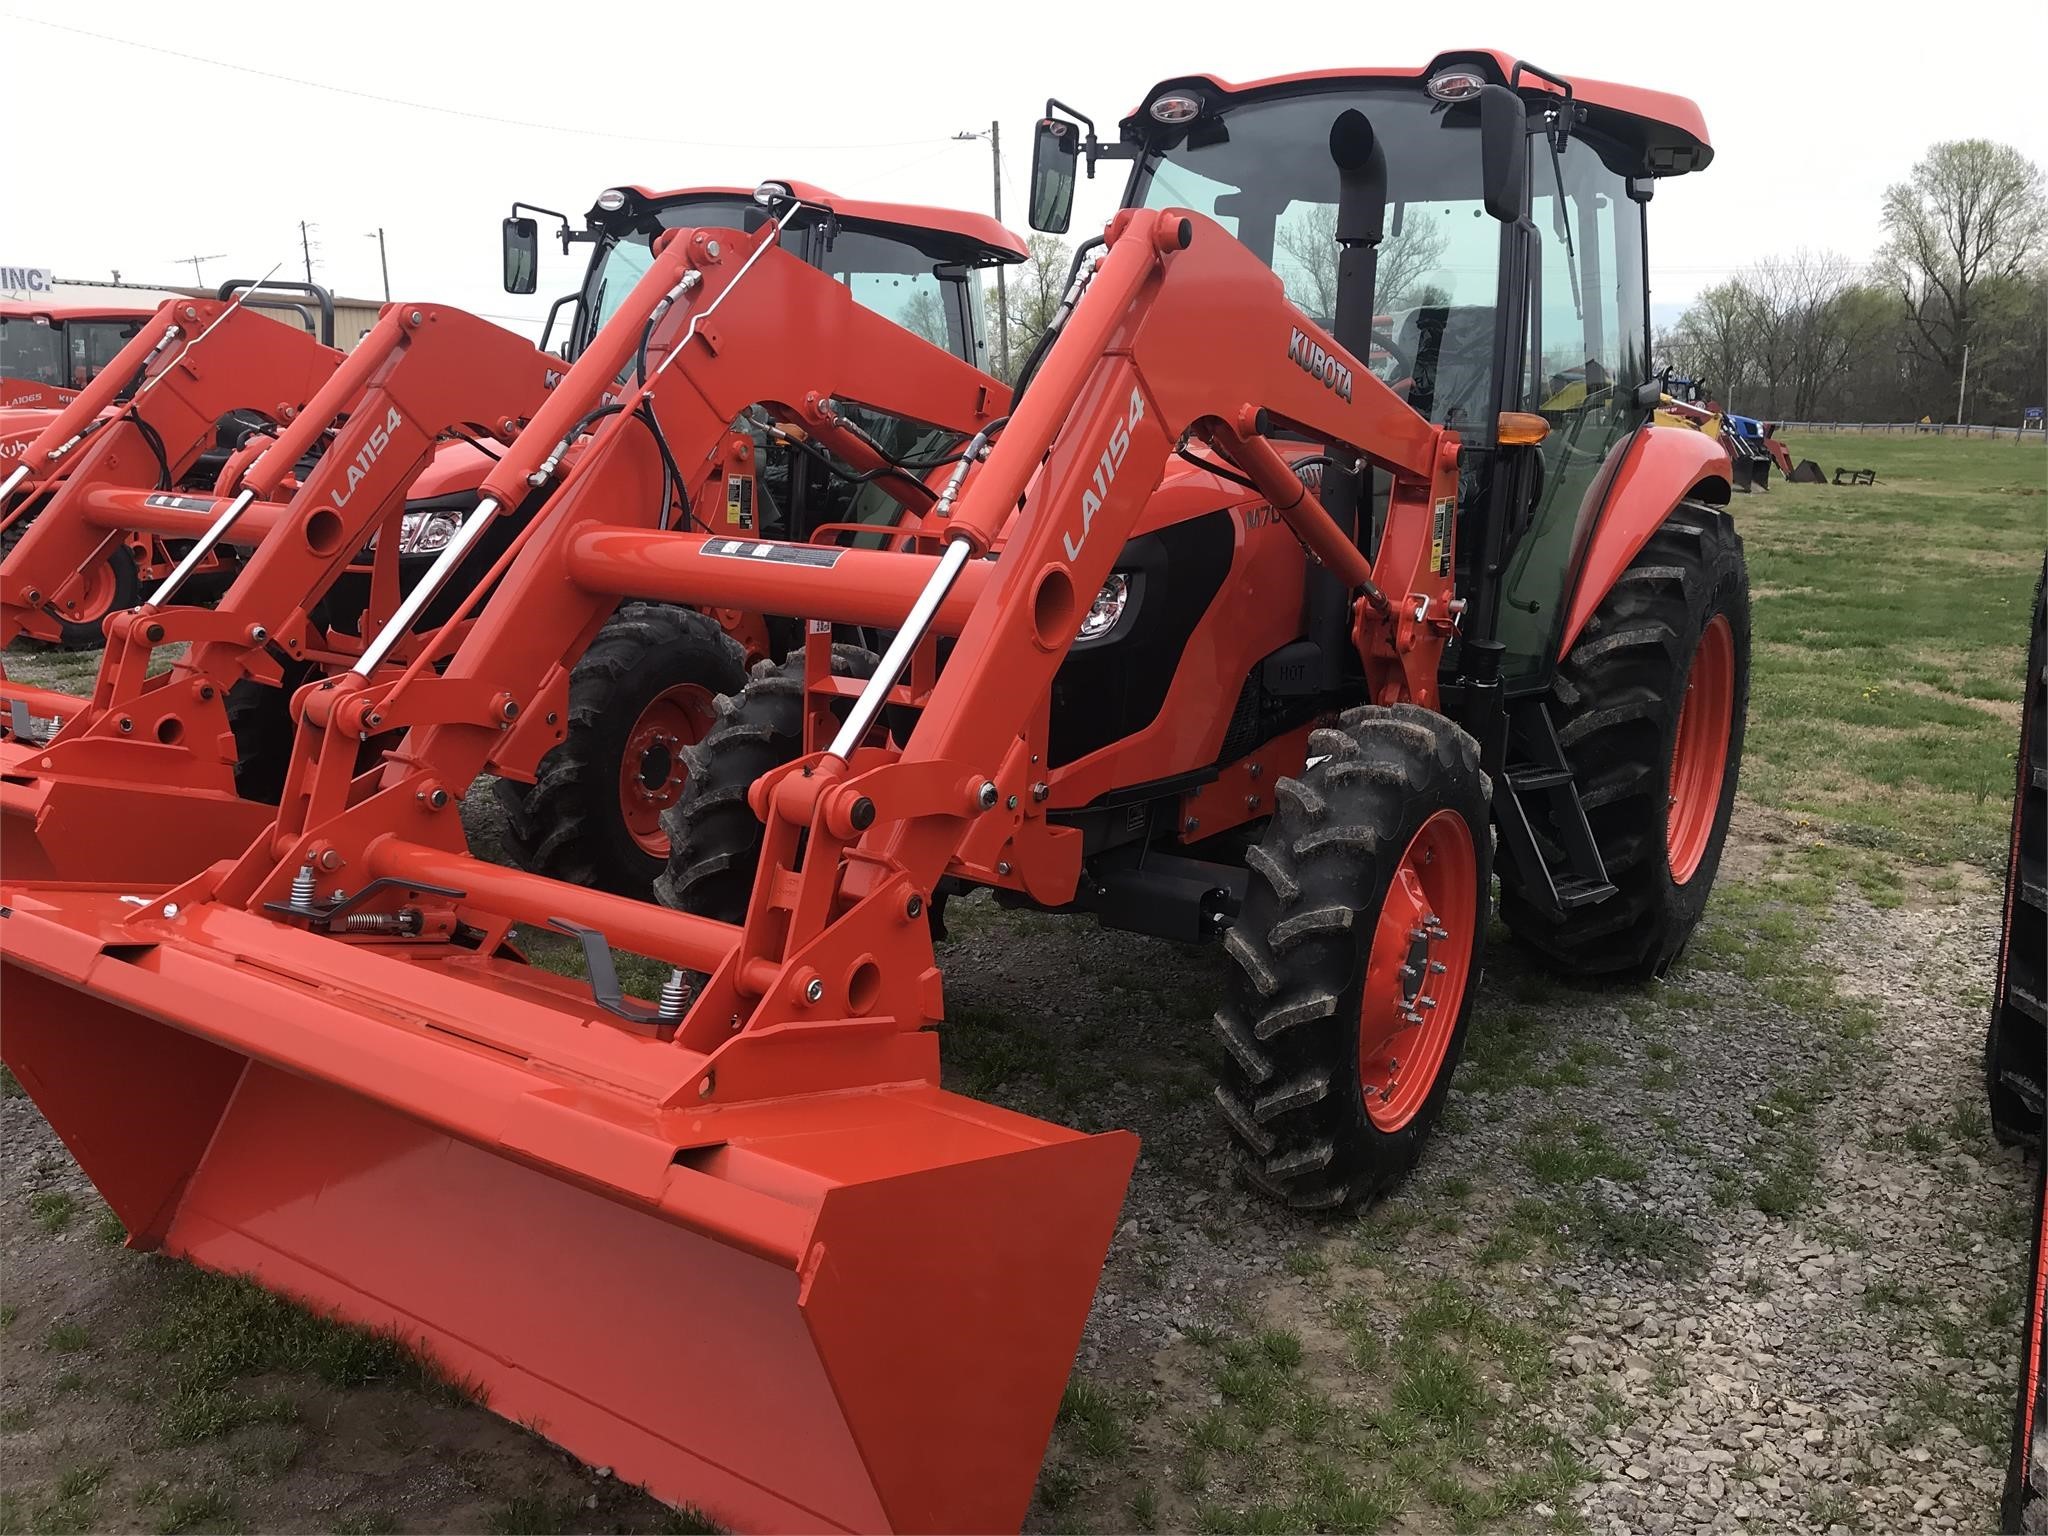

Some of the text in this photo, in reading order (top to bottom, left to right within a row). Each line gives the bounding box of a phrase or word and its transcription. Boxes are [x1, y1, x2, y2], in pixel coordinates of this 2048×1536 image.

[1, 267, 50, 291] INC.
[1288, 325, 1352, 404] KUBOTA
[330, 406, 402, 508] LA1154
[1063, 386, 1144, 562] LA1154
[1280, 664, 1305, 680] HOT
